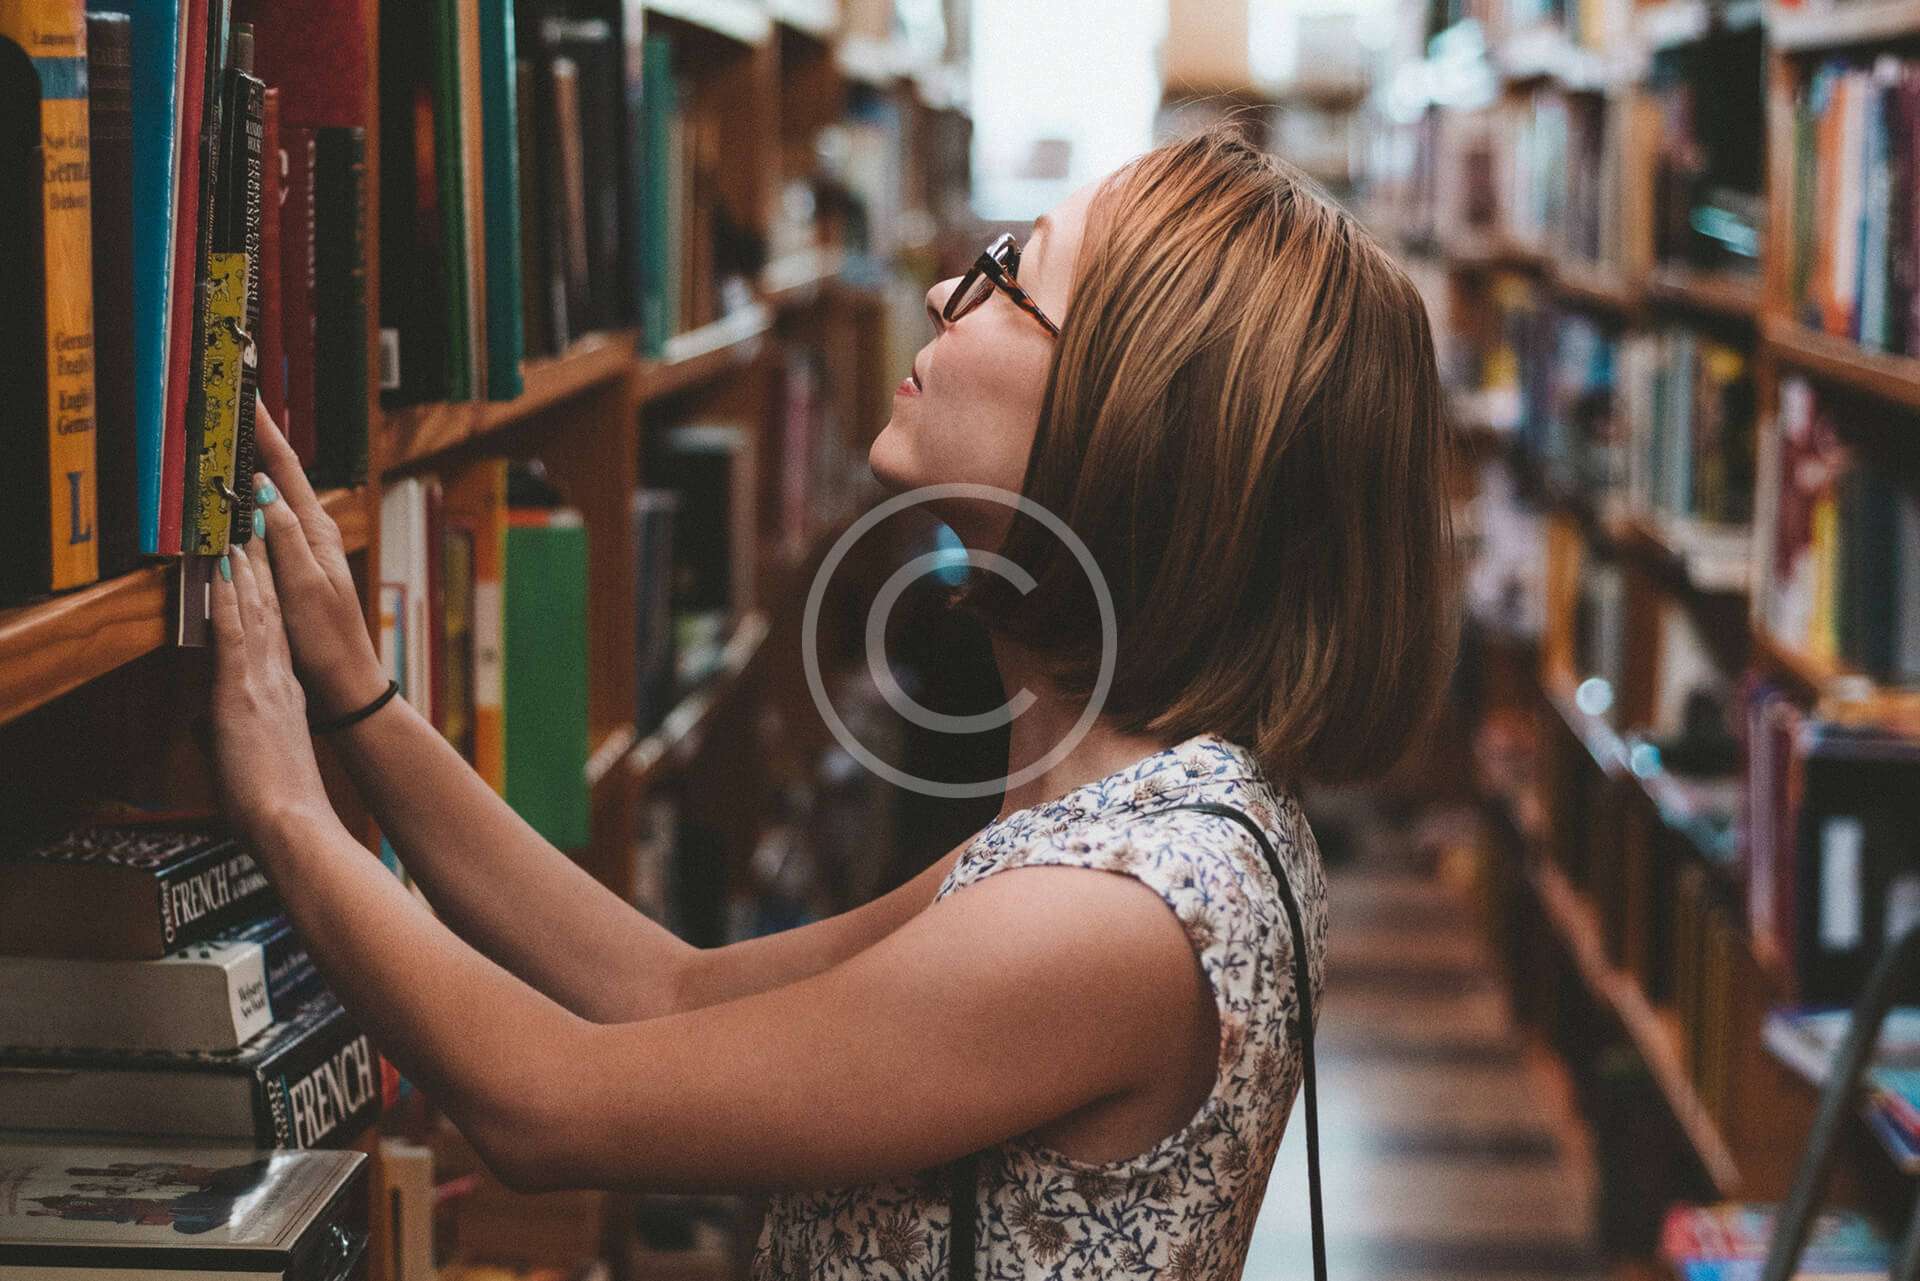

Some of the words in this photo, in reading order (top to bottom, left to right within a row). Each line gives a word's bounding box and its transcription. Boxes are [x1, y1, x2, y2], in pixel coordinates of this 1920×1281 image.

[66, 471, 92, 546] L
[172, 863, 231, 928] FRENCH
[289, 1034, 375, 1150] FRENCH
